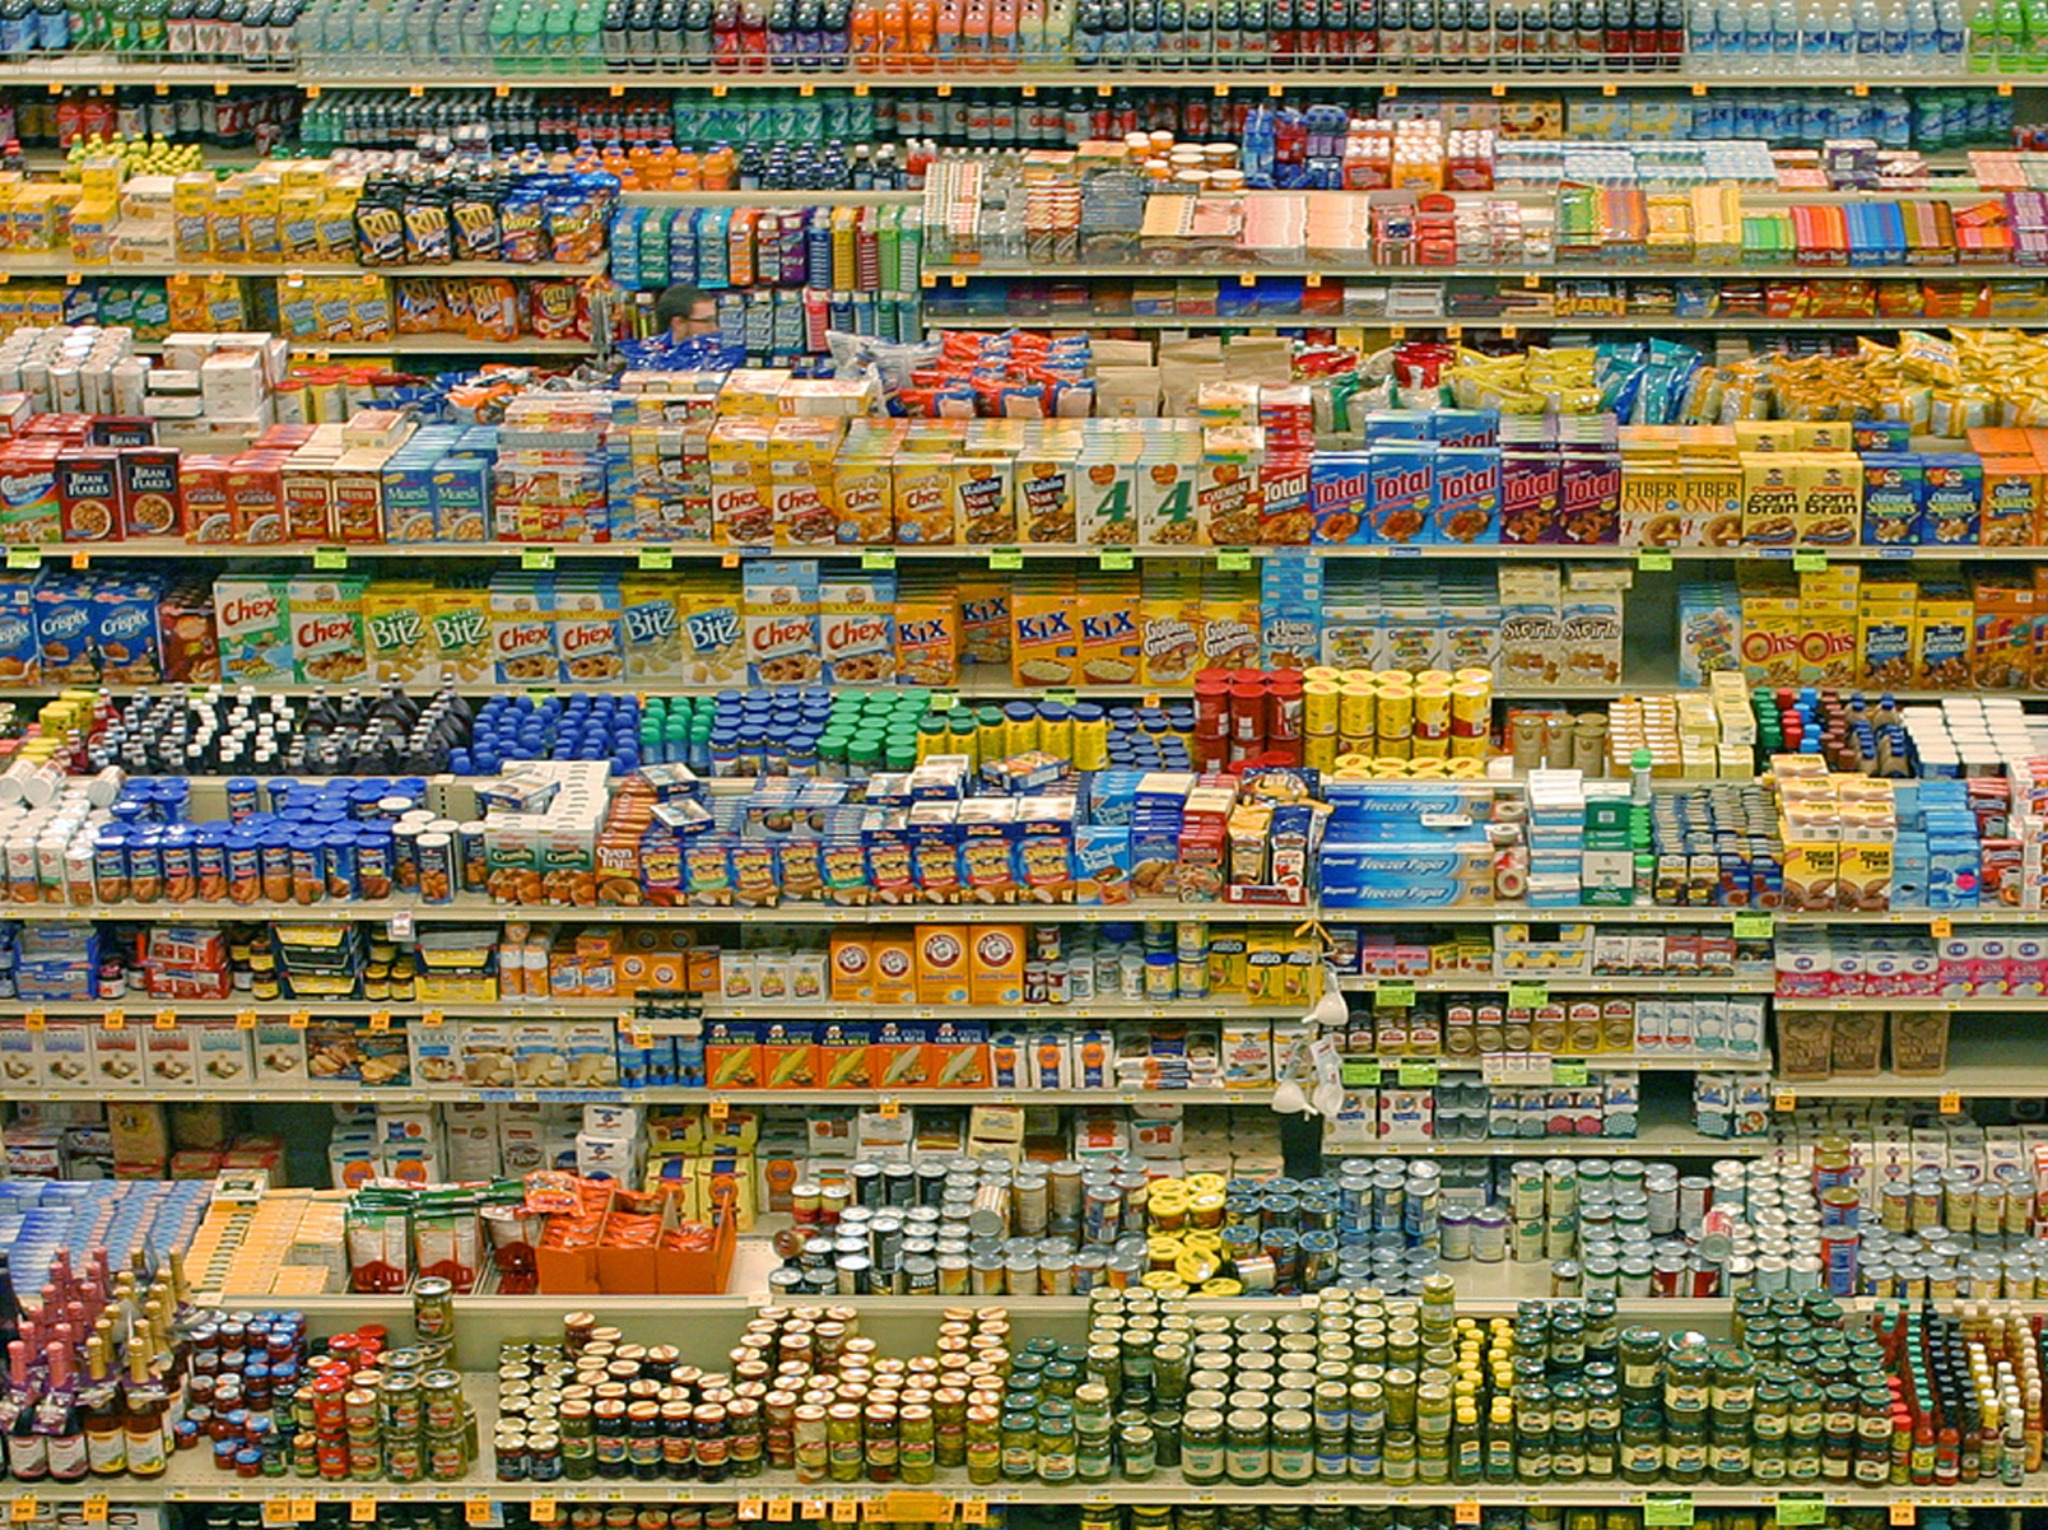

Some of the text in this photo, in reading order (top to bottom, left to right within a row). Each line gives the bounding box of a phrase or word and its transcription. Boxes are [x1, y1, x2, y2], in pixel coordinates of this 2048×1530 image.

[72, 472, 105, 485] BRAN
[132, 477, 172, 490] FLAKES
[135, 465, 167, 481] BRAN
[1374, 465, 1431, 502] Total
[1439, 465, 1496, 502] Total
[1503, 469, 1559, 501] Total
[1563, 469, 1619, 501] Total
[68, 484, 109, 497] FLAKES
[718, 486, 760, 512] Chex
[777, 486, 820, 512] Chex
[1262, 473, 1308, 503] Total
[1314, 472, 1367, 505] Total
[1626, 481, 1677, 498] FIBER
[1685, 481, 1738, 498] FIBER
[1750, 493, 1798, 503] corn
[1808, 493, 1856, 503] corn
[1096, 480, 1131, 523] 4
[1157, 480, 1192, 523] 4
[1623, 499, 1664, 513] ONE
[1682, 499, 1723, 513] ONE
[1747, 500, 1799, 515] bran
[1805, 500, 1857, 515] bran
[41, 608, 90, 637] Crispix
[101, 608, 149, 637] Crispix
[222, 598, 278, 627] Chex
[624, 606, 679, 640] Bitz
[298, 619, 354, 648] Chex
[368, 616, 425, 649] Bitz
[432, 616, 489, 649] Bitz
[499, 625, 549, 651] Chex
[562, 625, 614, 651] Chex
[686, 614, 742, 650] Bitz
[753, 621, 811, 651] Chex
[827, 621, 885, 650] Chex
[1742, 629, 1800, 663] Oh's
[1800, 629, 1856, 663] Oh's
[1363, 799, 1408, 813] Freezer
[1409, 799, 1449, 816] Paper
[596, 846, 633, 860] Oven
[1358, 857, 1406, 871] Freezer
[1407, 858, 1446, 874] Paper
[1805, 850, 1834, 860] SUGAR
[1810, 858, 1835, 869] TWIN
[1860, 850, 1889, 860] SUGAR
[1865, 858, 1890, 869] TWIN
[1358, 885, 1406, 899] Freezer
[1407, 886, 1446, 902] Paper
[1211, 942, 1244, 954] ARGO
[1250, 953, 1282, 965] ARGO
[1287, 953, 1312, 964] ARG
